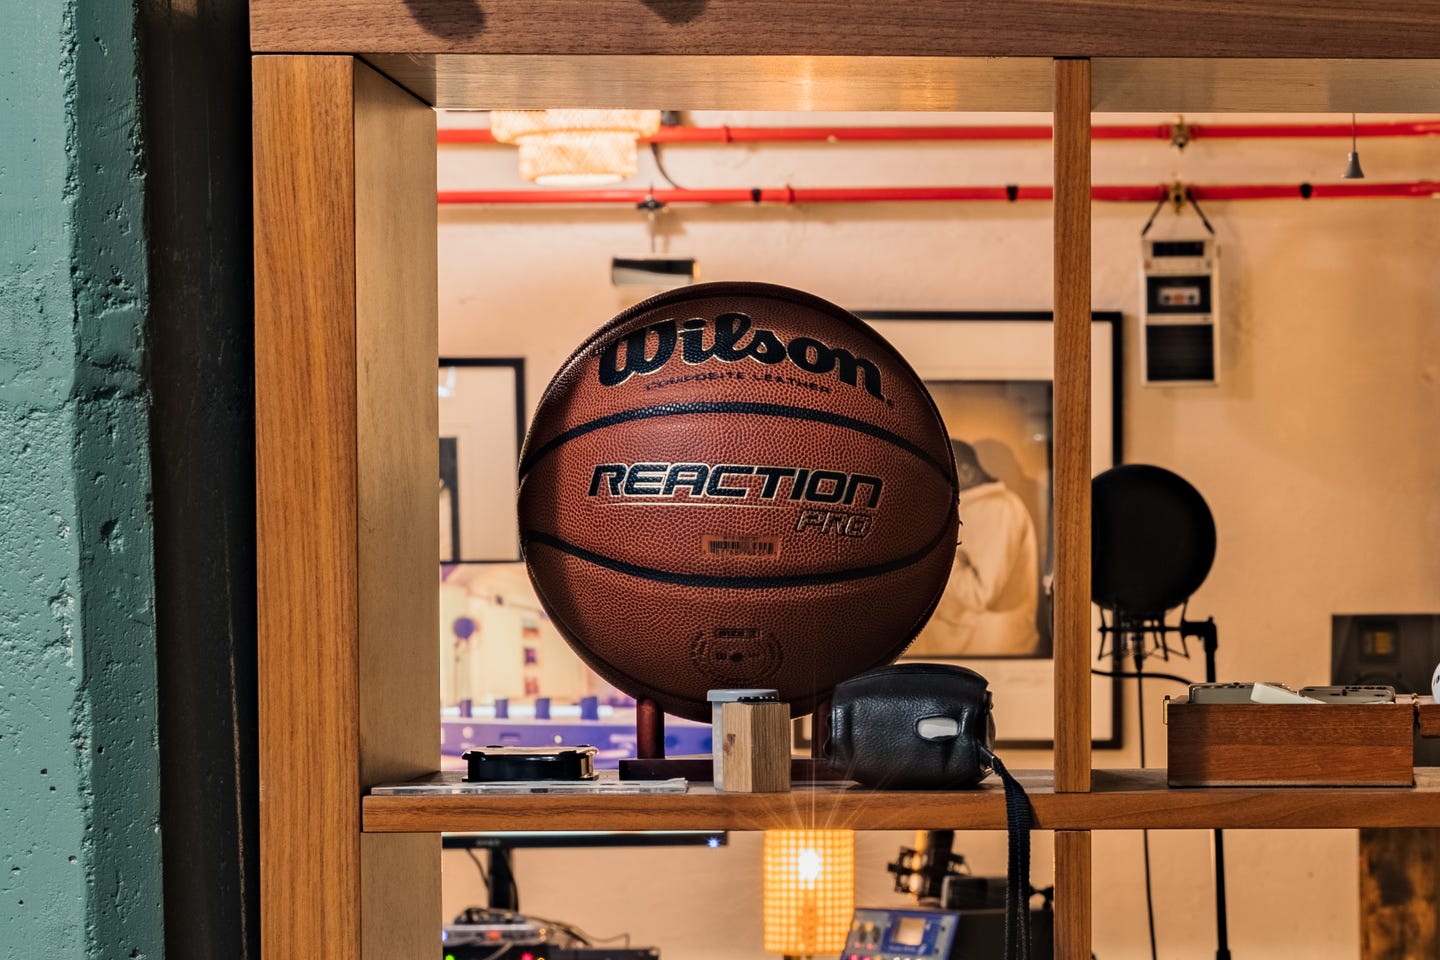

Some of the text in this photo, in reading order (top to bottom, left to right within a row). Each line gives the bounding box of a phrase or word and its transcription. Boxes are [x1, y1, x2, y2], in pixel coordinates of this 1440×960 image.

[599, 312, 885, 399] Wilson
[752, 374, 831, 394] LEATHER
[588, 462, 883, 509] REACTION
[796, 509, 873, 538] PRO
